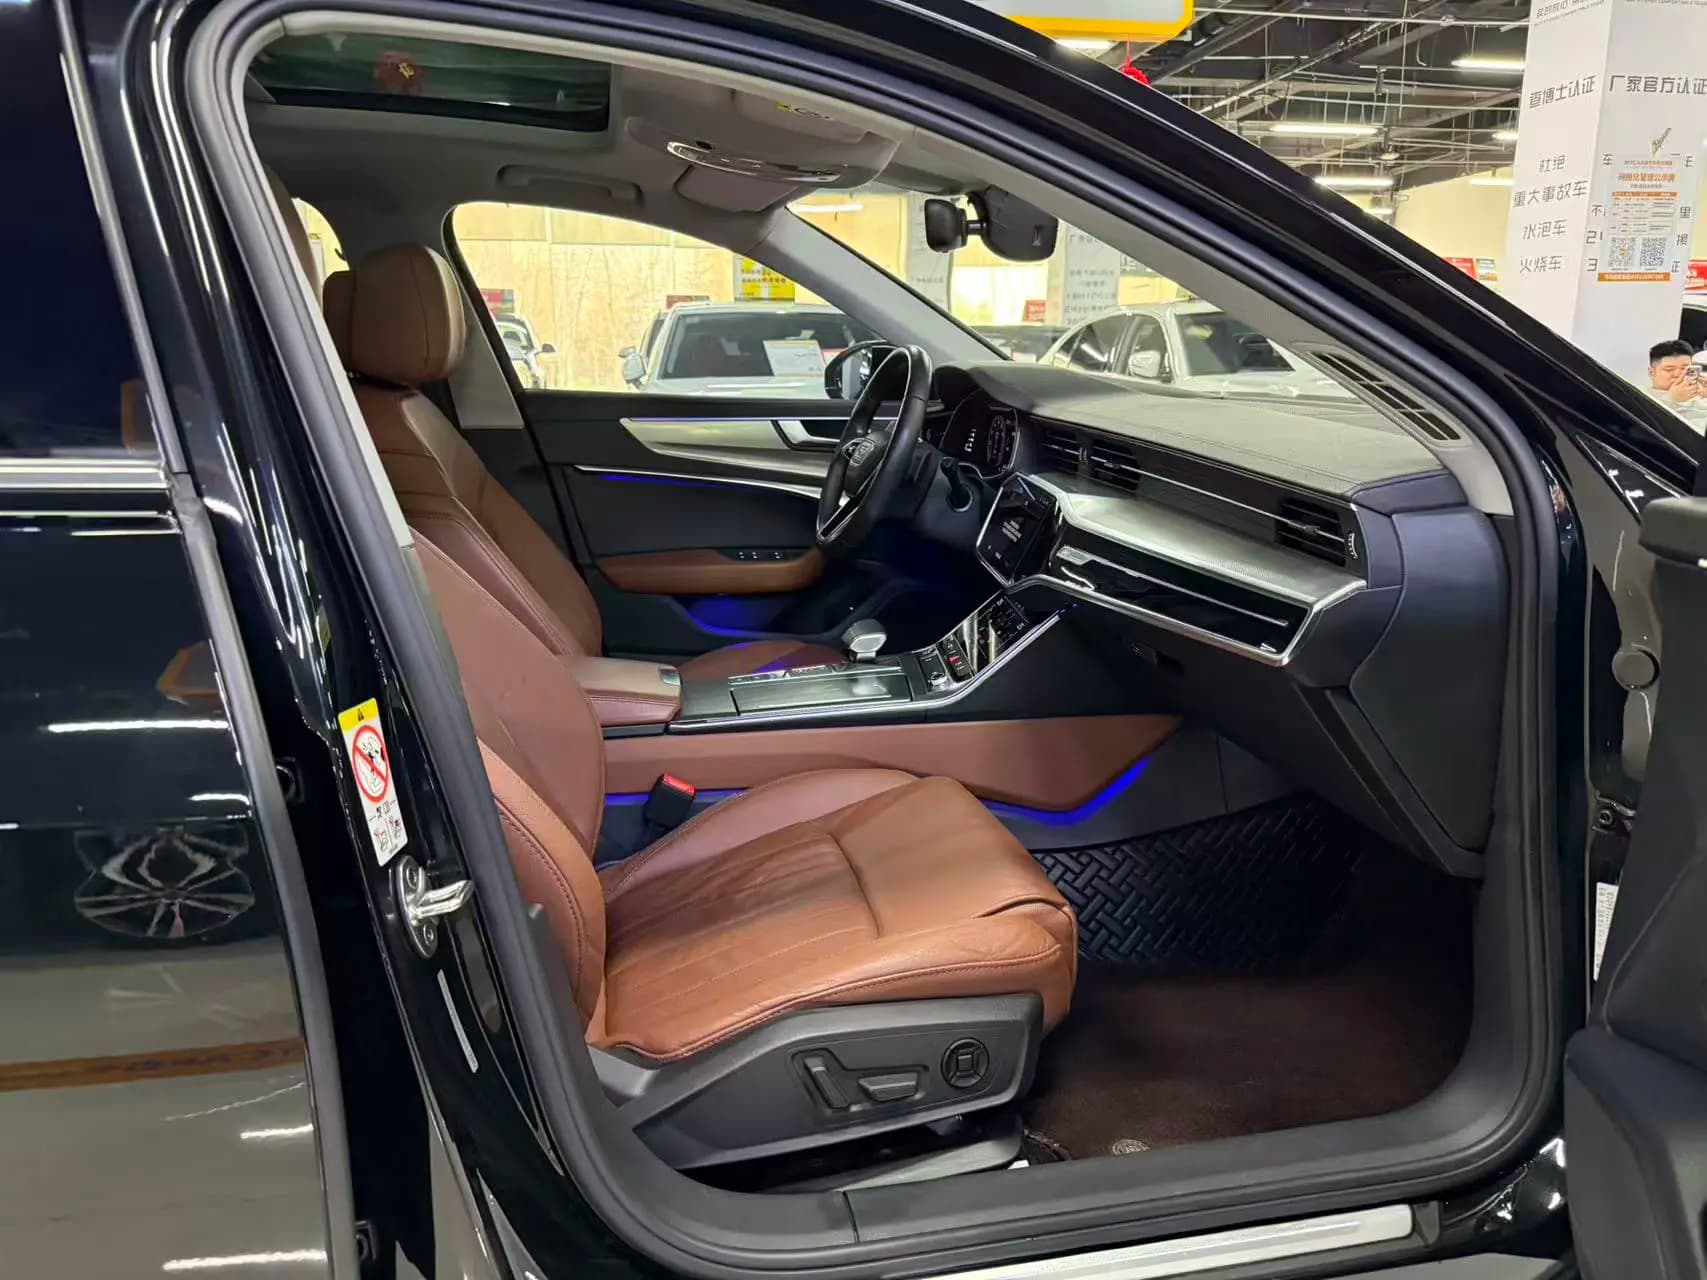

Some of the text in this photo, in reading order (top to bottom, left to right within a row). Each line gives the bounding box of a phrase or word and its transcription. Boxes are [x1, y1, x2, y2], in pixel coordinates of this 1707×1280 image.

[1529, 75, 1596, 109] 查博士认证
[1609, 75, 1707, 95] 厂家官方认证
[1539, 155, 1566, 173] 杜绝
[1513, 180, 1588, 207] 重大事故车
[1522, 219, 1568, 240] 水泡车
[1519, 255, 1563, 274] 火烧车
